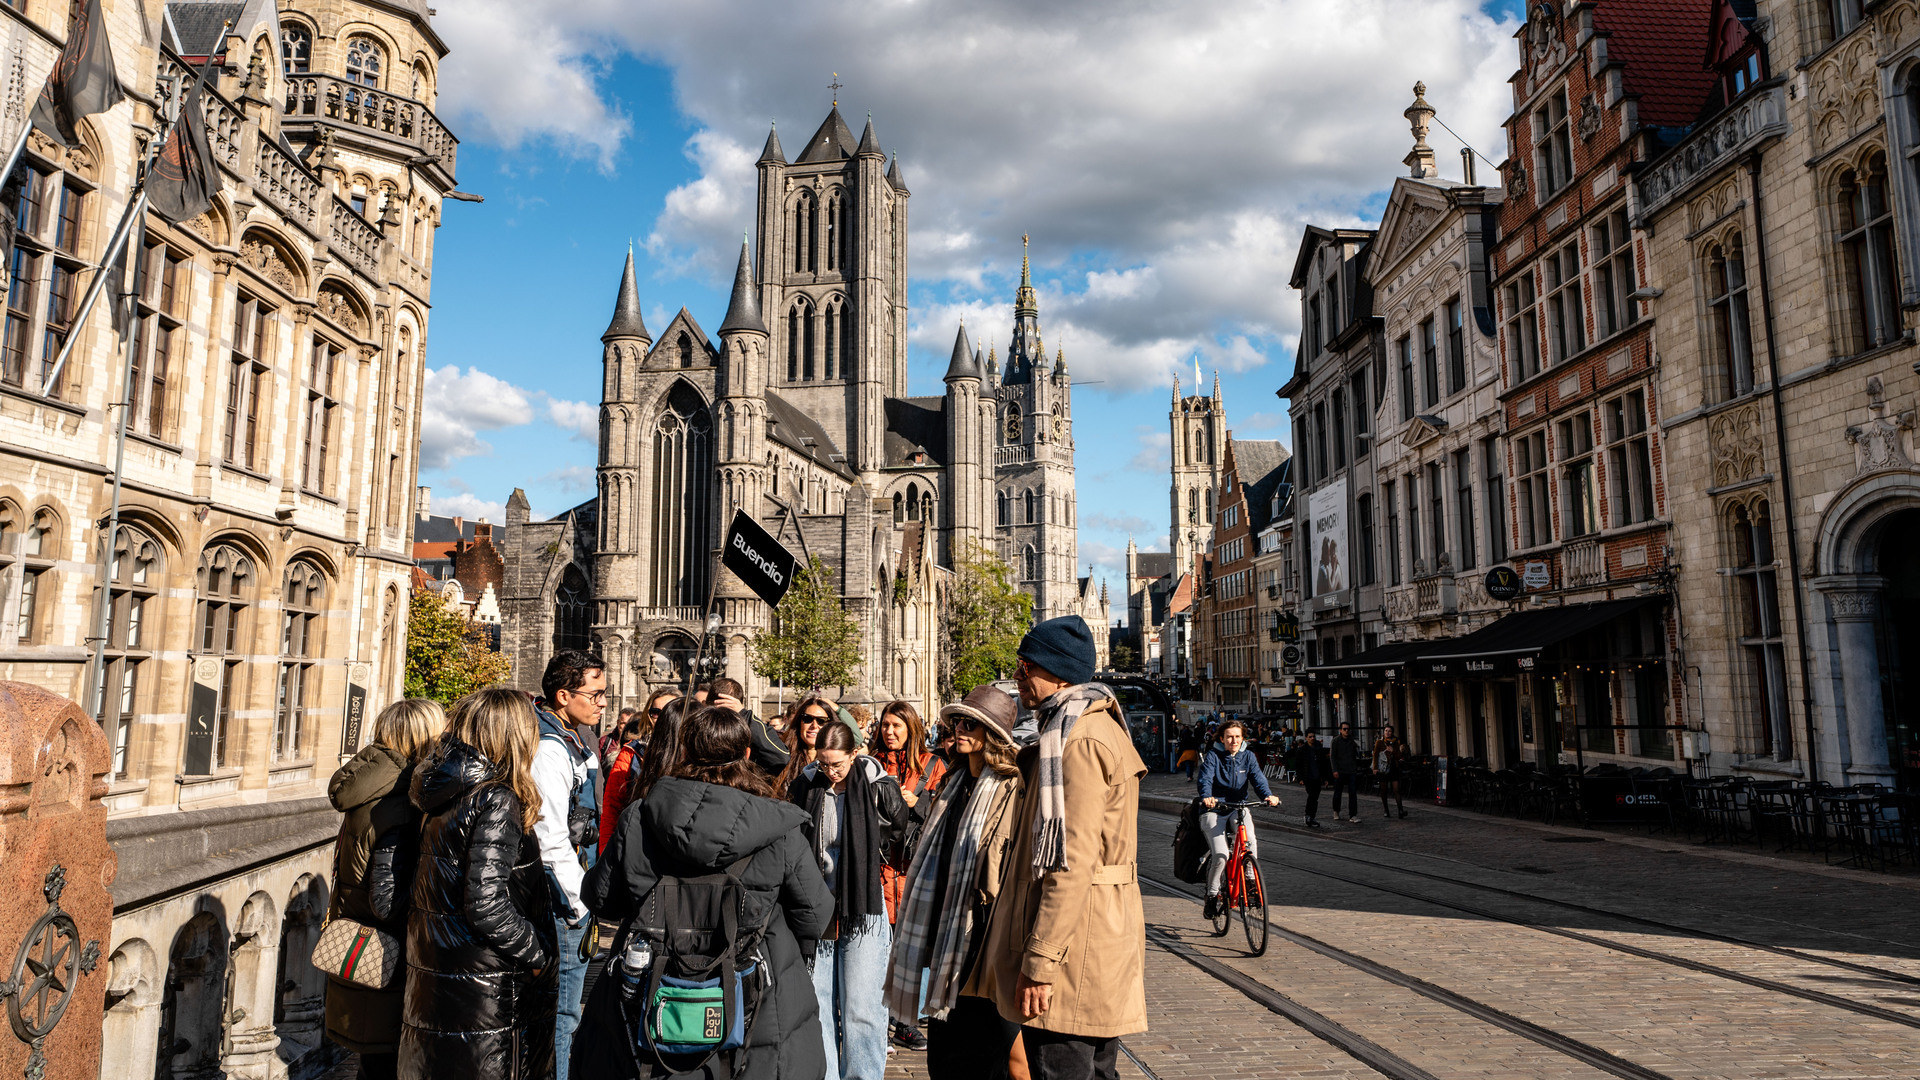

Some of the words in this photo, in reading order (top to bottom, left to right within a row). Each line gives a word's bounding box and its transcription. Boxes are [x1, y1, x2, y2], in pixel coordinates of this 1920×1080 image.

[732, 532, 784, 586] Buendía
[706, 1017, 721, 1028] igu
[705, 1026, 720, 1038] al.
